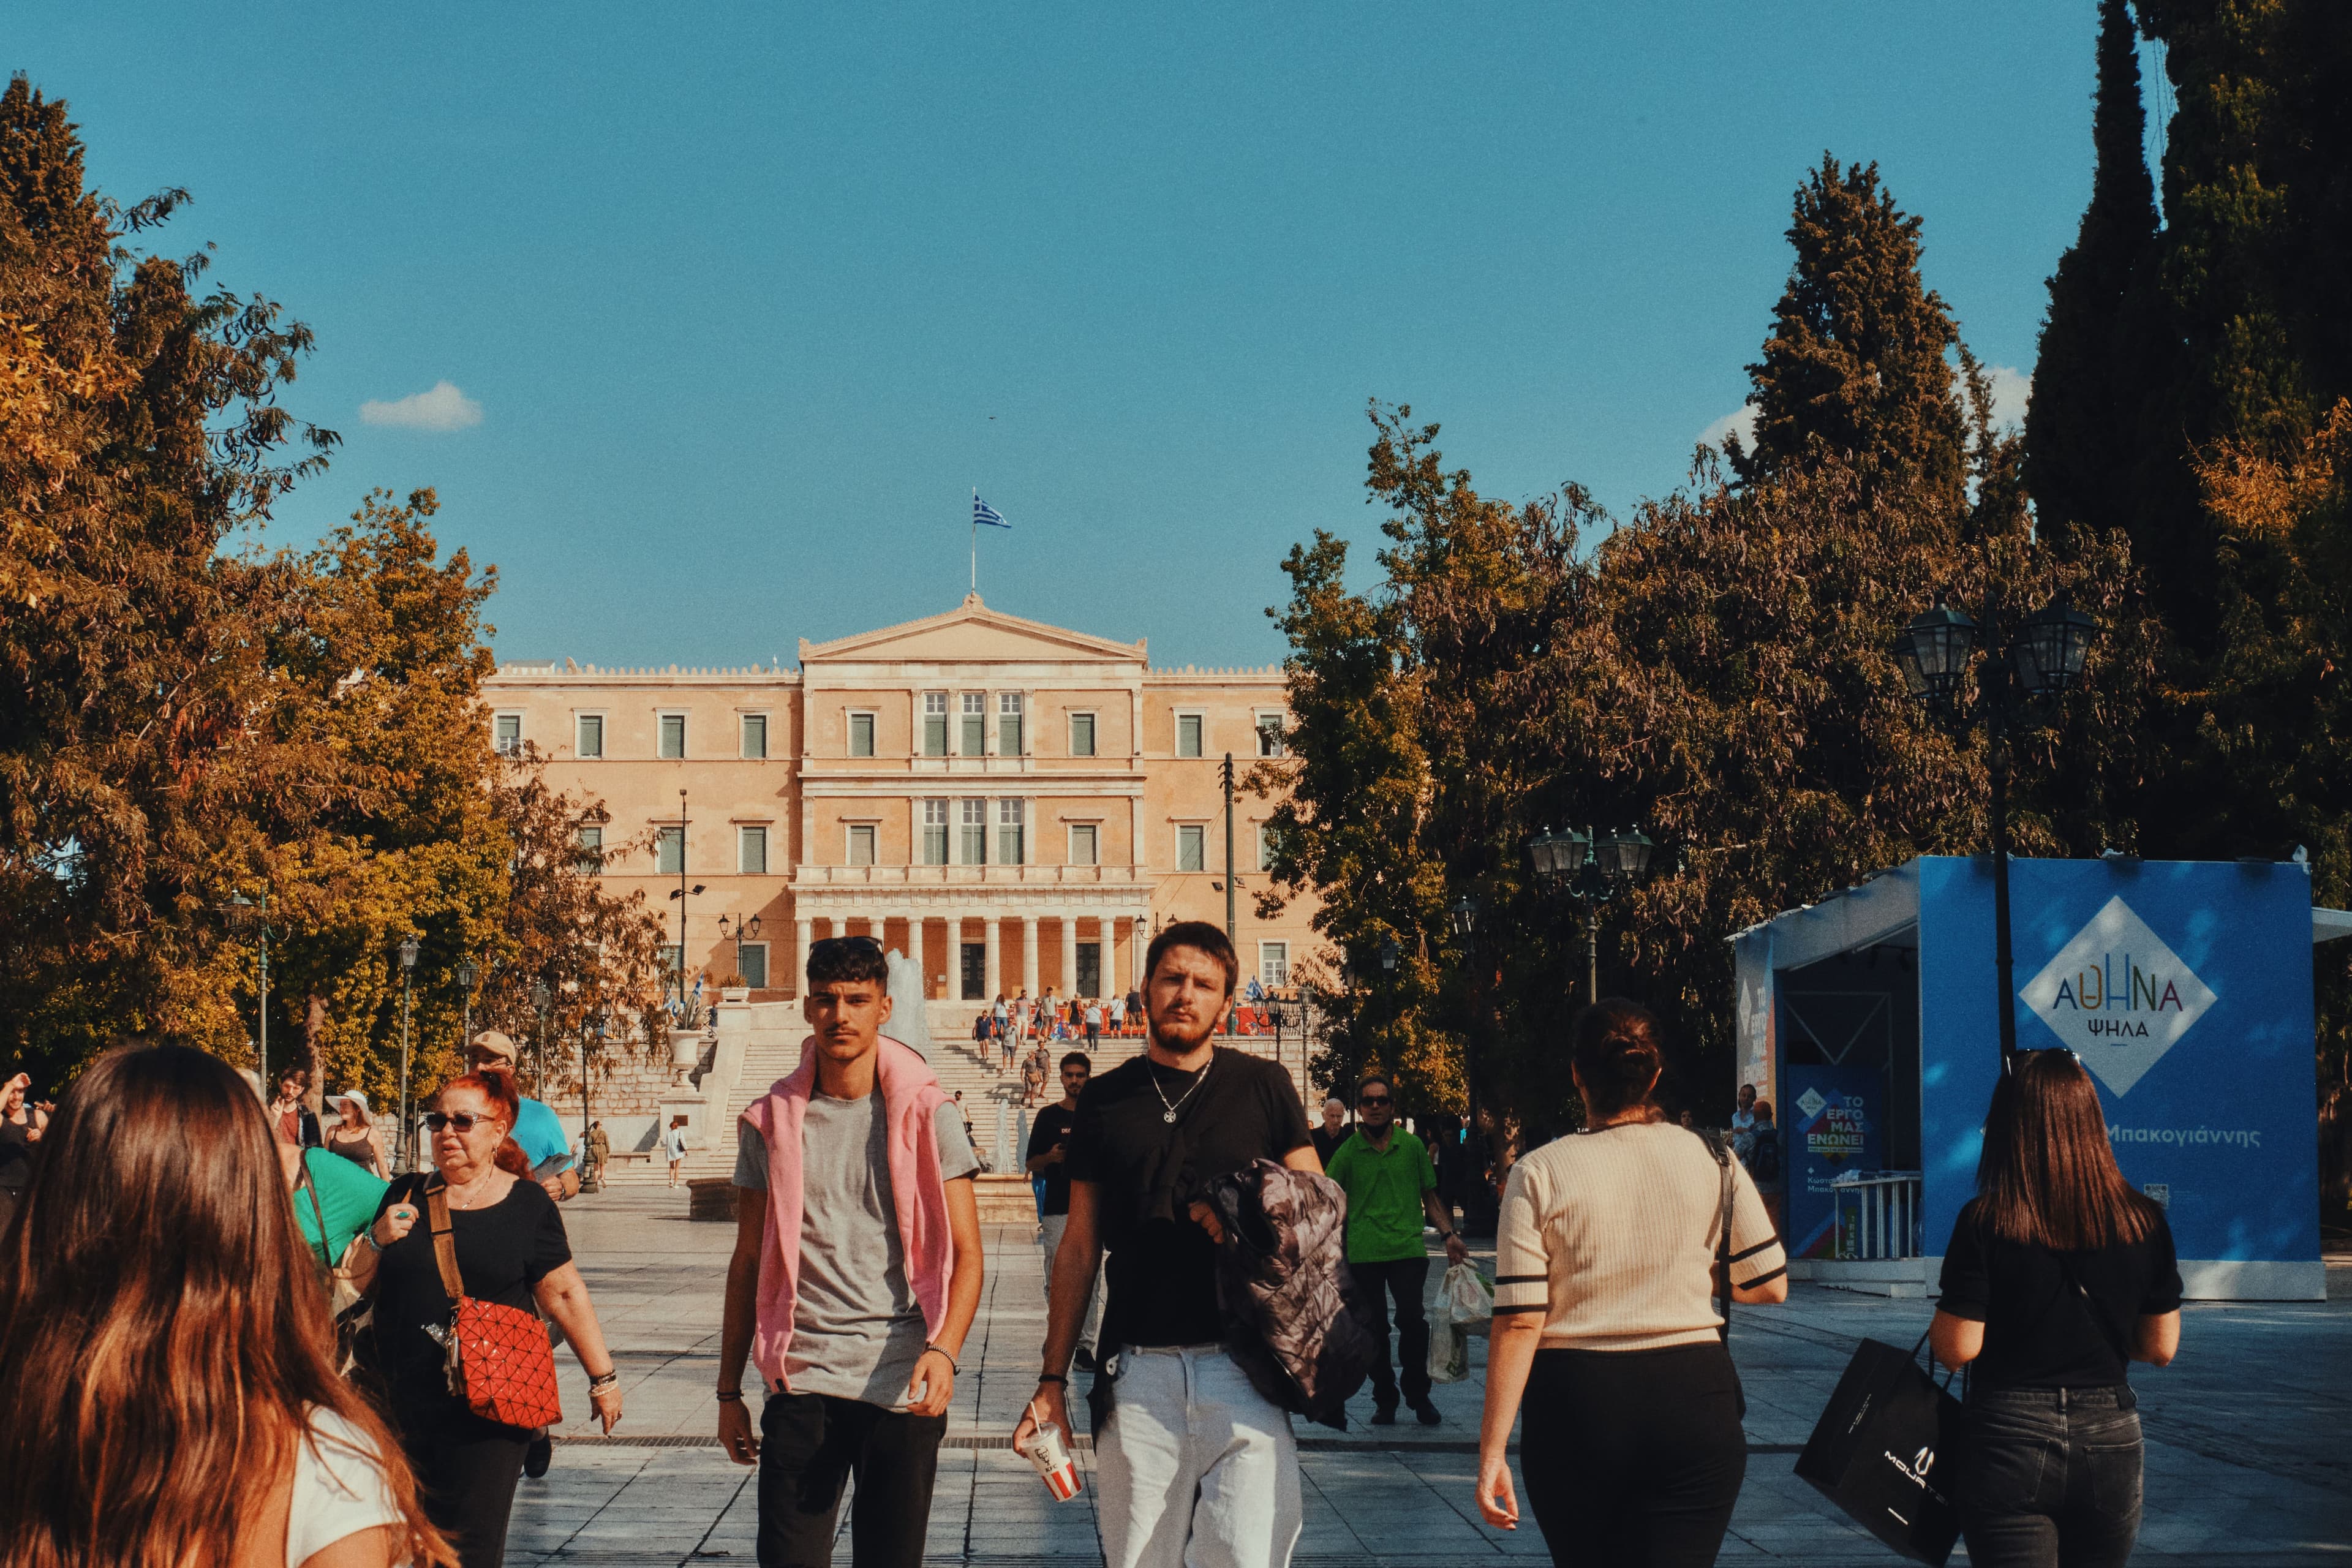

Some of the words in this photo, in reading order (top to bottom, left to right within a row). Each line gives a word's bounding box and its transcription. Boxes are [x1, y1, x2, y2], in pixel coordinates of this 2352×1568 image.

[2052, 952, 2184, 1011] ΑΘΗΝΑ
[2088, 1019, 2149, 1037] ΨΗΛΑ
[1843, 1096, 1864, 1107] ΤΟ
[1826, 1109, 1864, 1120] ΕΡΓΟ
[1831, 1121, 1864, 1133] ΜΑΣ
[1807, 1134, 1864, 1145] ΕΝΩΝΕΙ
[1046, 1463, 1057, 1472] KFC
